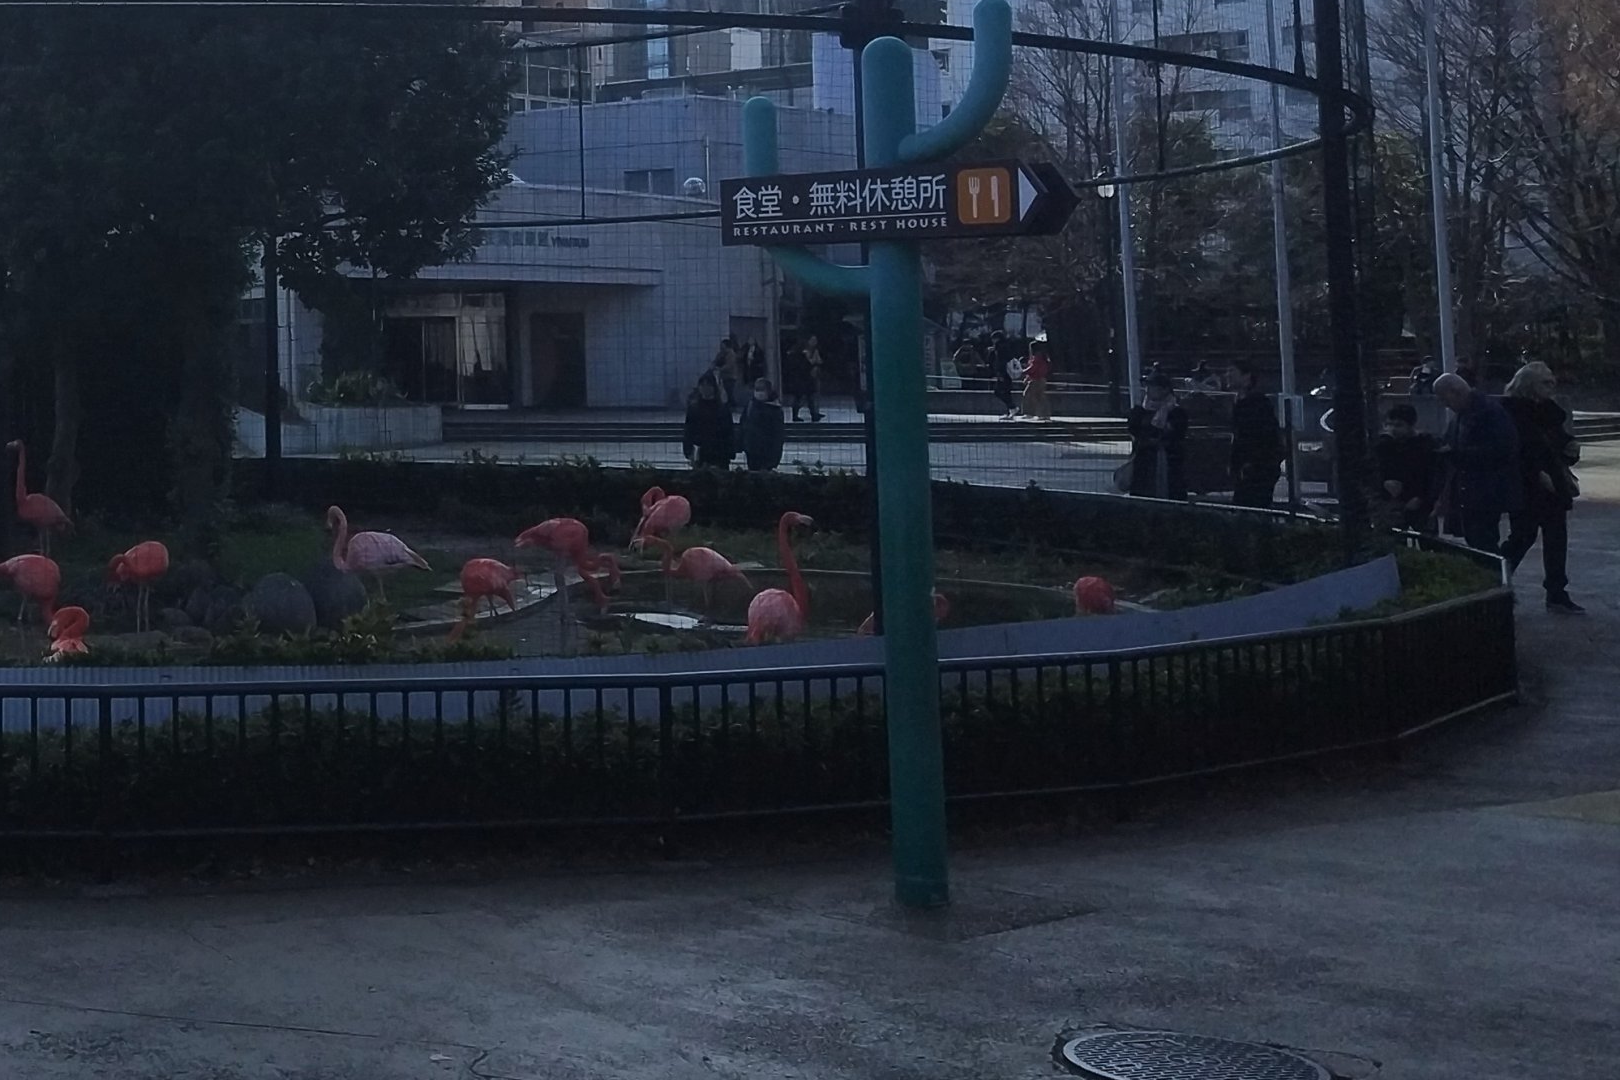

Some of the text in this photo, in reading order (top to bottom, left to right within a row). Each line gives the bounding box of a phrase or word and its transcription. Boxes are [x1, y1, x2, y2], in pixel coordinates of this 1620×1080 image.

[732, 173, 947, 220] 食堂・無料休憩所
[732, 216, 948, 237] RESTAURANT REST HOUSE
